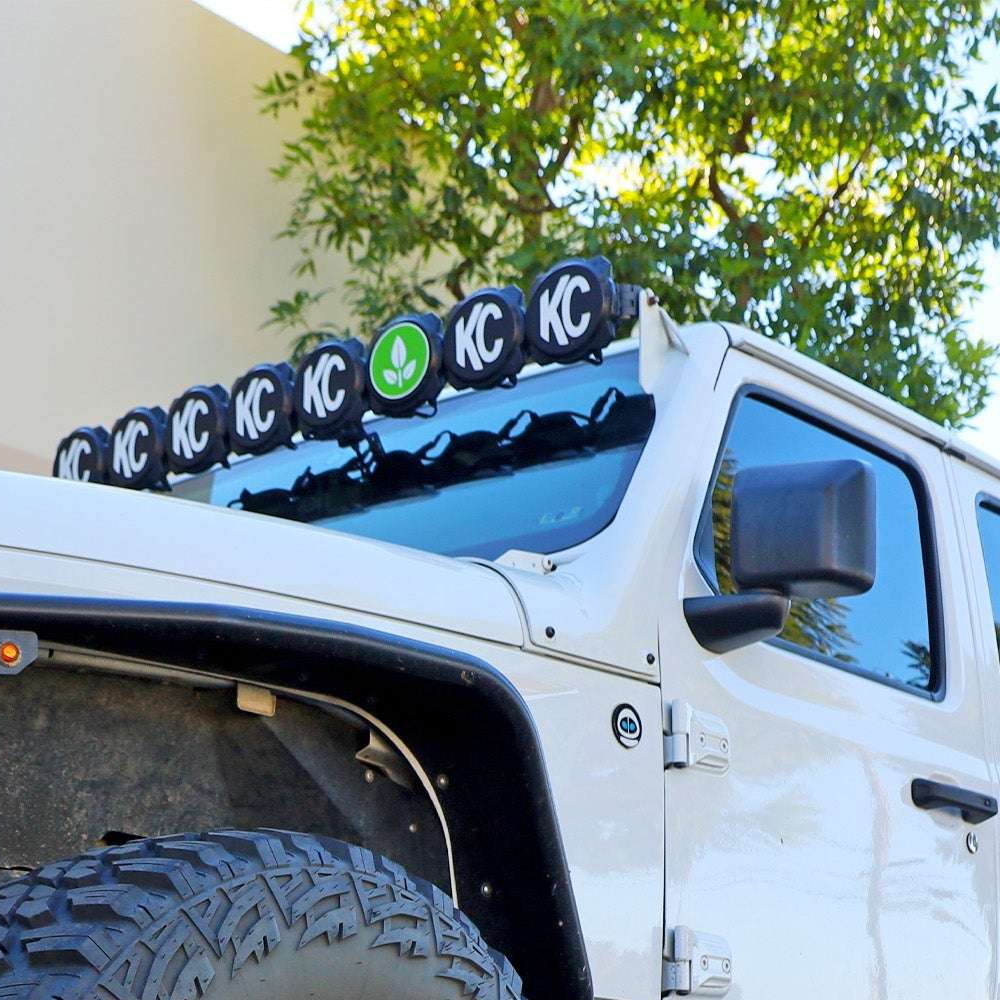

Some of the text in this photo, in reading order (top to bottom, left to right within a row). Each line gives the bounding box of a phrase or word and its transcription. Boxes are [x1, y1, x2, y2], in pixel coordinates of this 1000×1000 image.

[455, 302, 503, 372] KC
[539, 273, 590, 346] KC
[235, 377, 275, 440] KC
[303, 353, 346, 418] KC
[58, 438, 92, 482] KC
[112, 419, 149, 478] KC
[172, 399, 210, 459] KC
